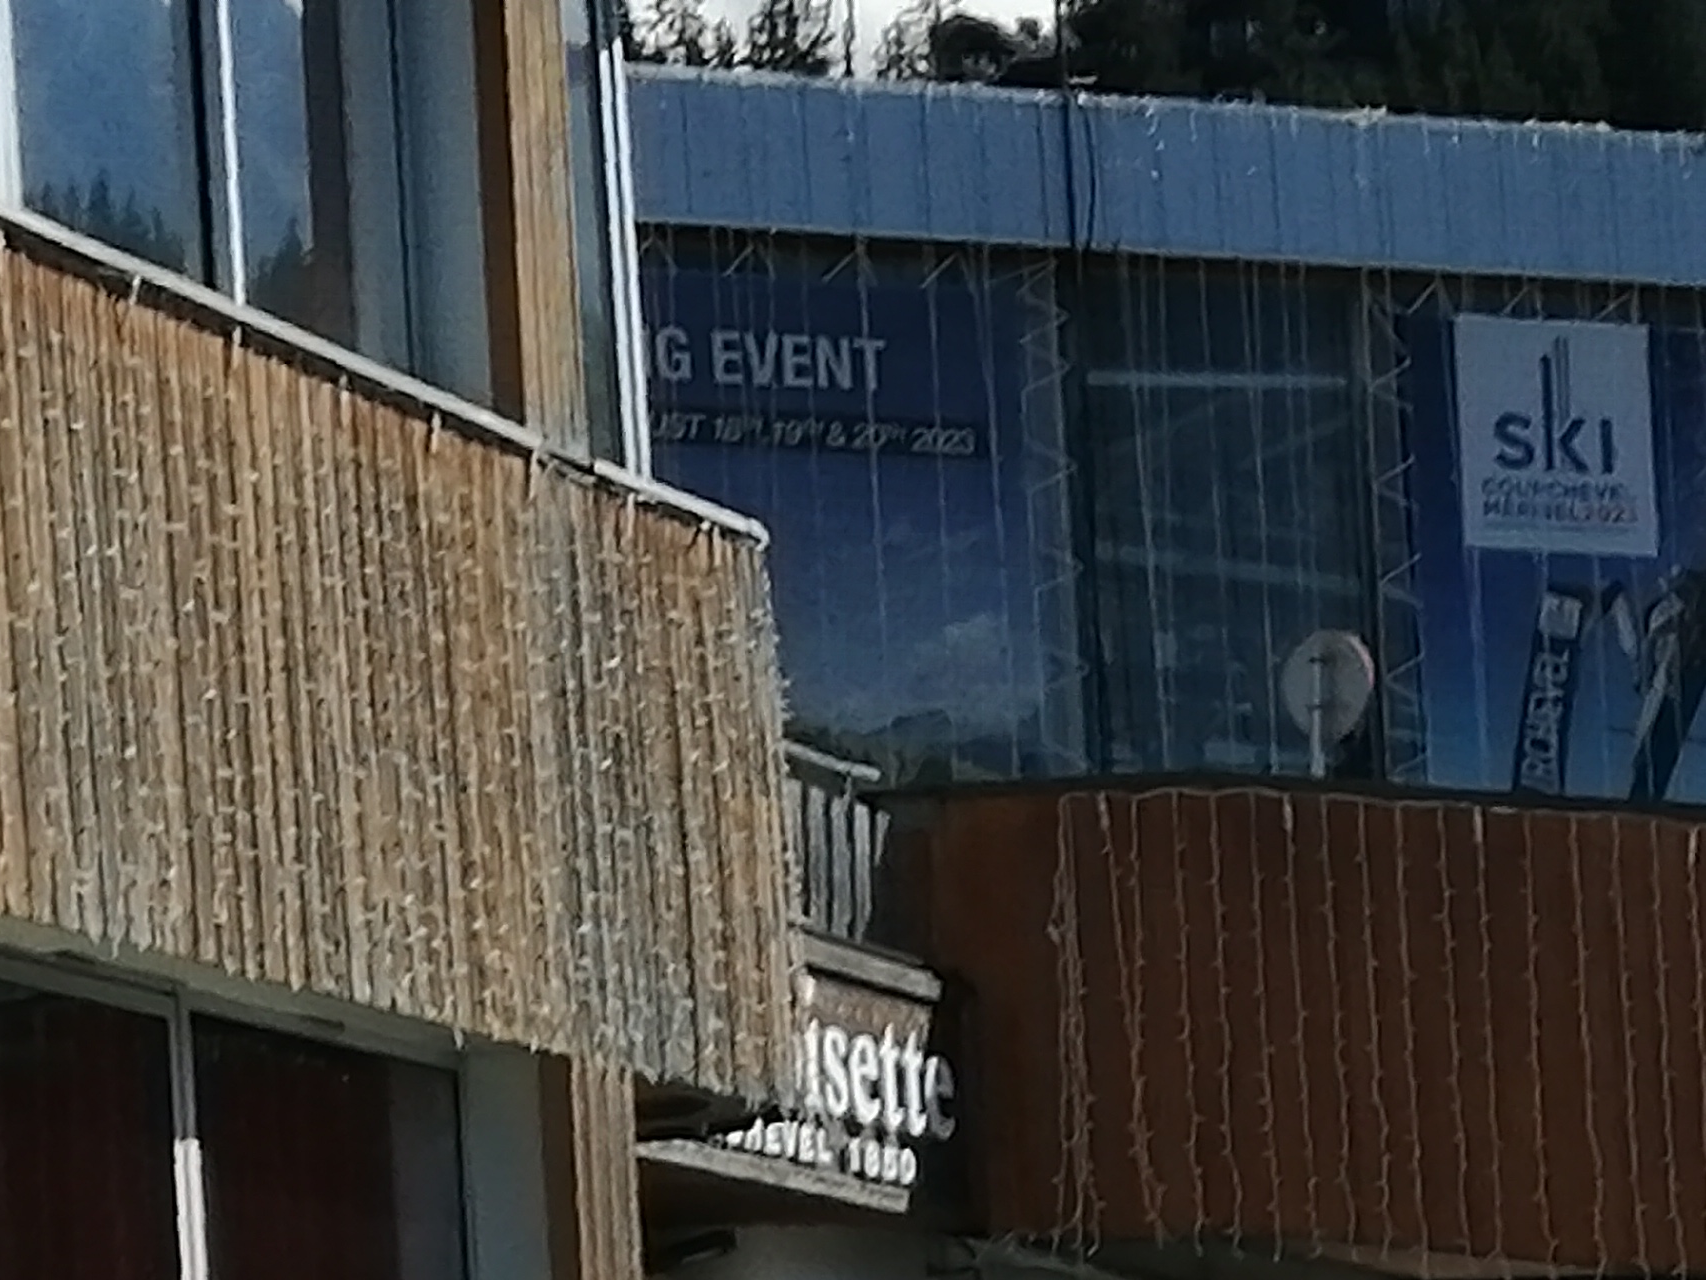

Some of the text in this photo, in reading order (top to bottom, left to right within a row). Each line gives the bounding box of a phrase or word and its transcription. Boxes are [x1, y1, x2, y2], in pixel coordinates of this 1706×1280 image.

[711, 329, 886, 390] EVENT
[826, 420, 846, 447] &
[911, 425, 975, 456] 2023
